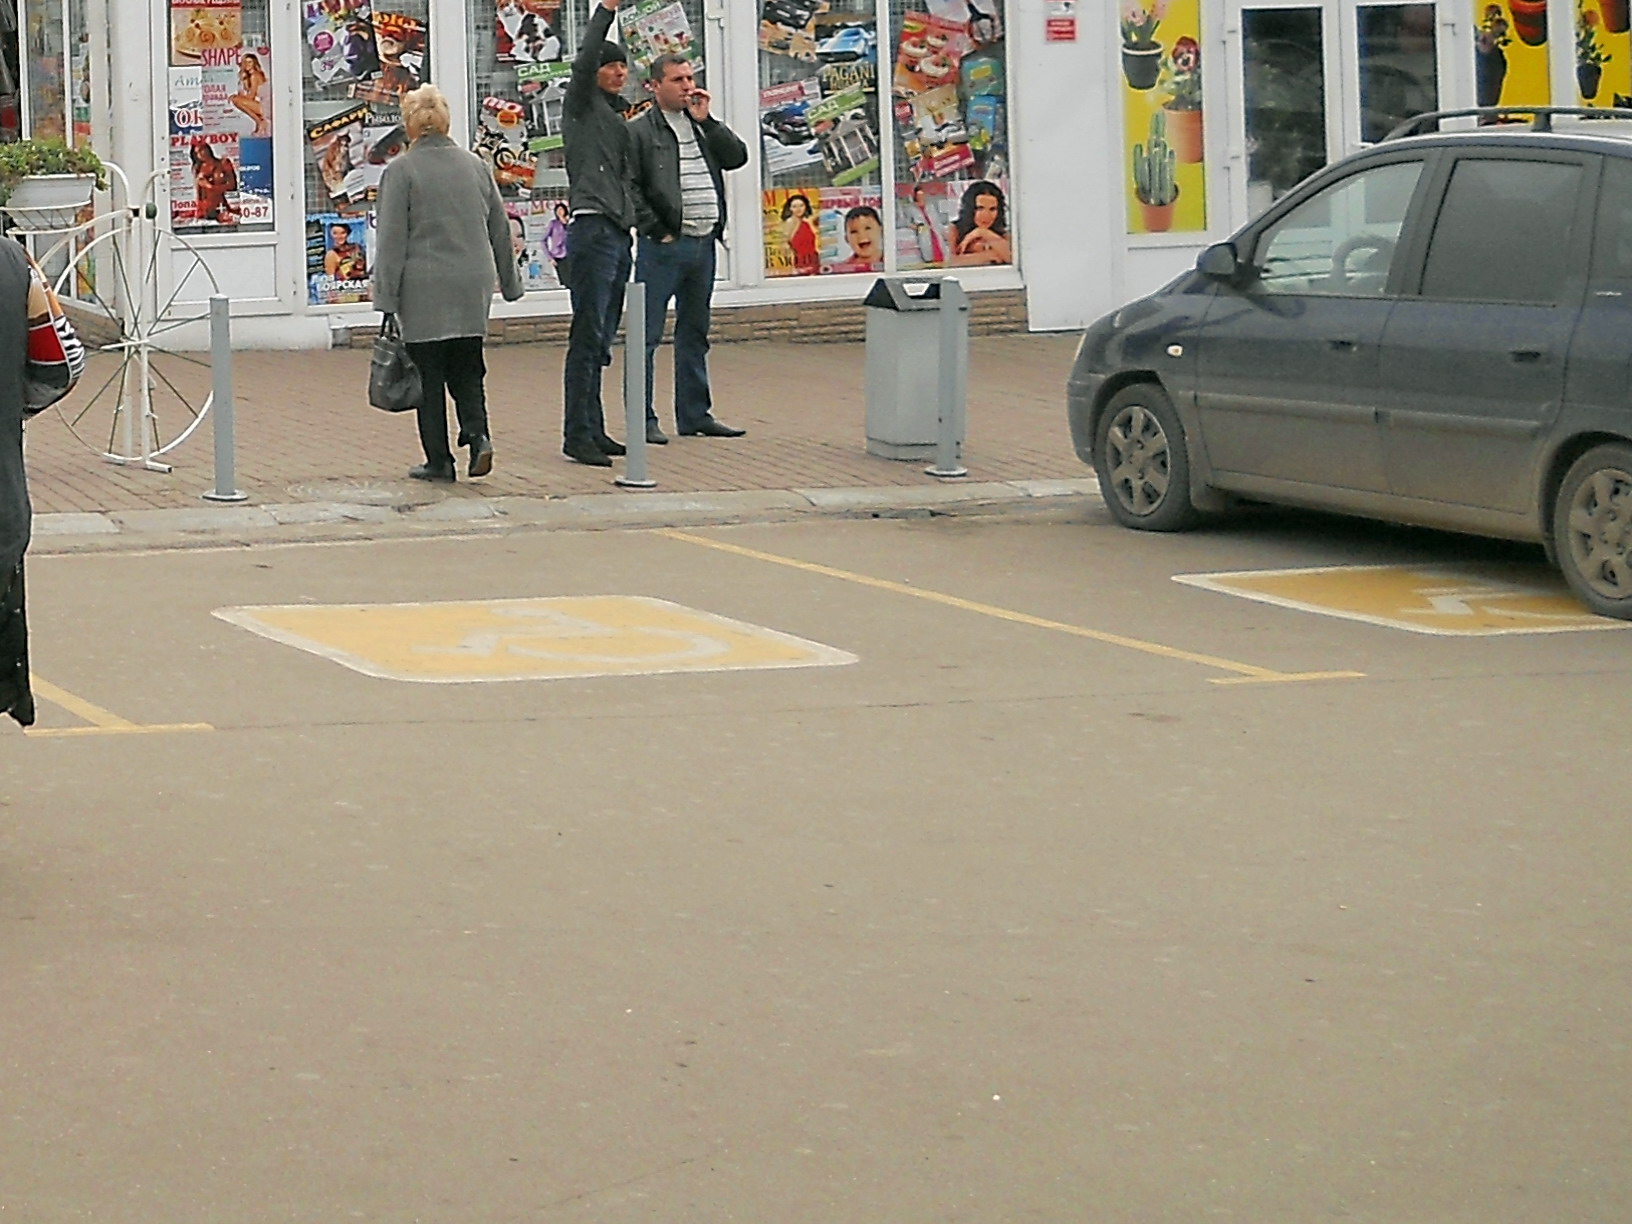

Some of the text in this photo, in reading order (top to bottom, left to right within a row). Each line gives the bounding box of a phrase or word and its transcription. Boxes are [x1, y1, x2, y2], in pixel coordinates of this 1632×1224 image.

[201, 48, 242, 67] SHAPE
[517, 63, 551, 77] САД
[808, 99, 839, 119] САД
[310, 108, 368, 139] САФАРИ
[171, 133, 238, 146] PLAYBOY
